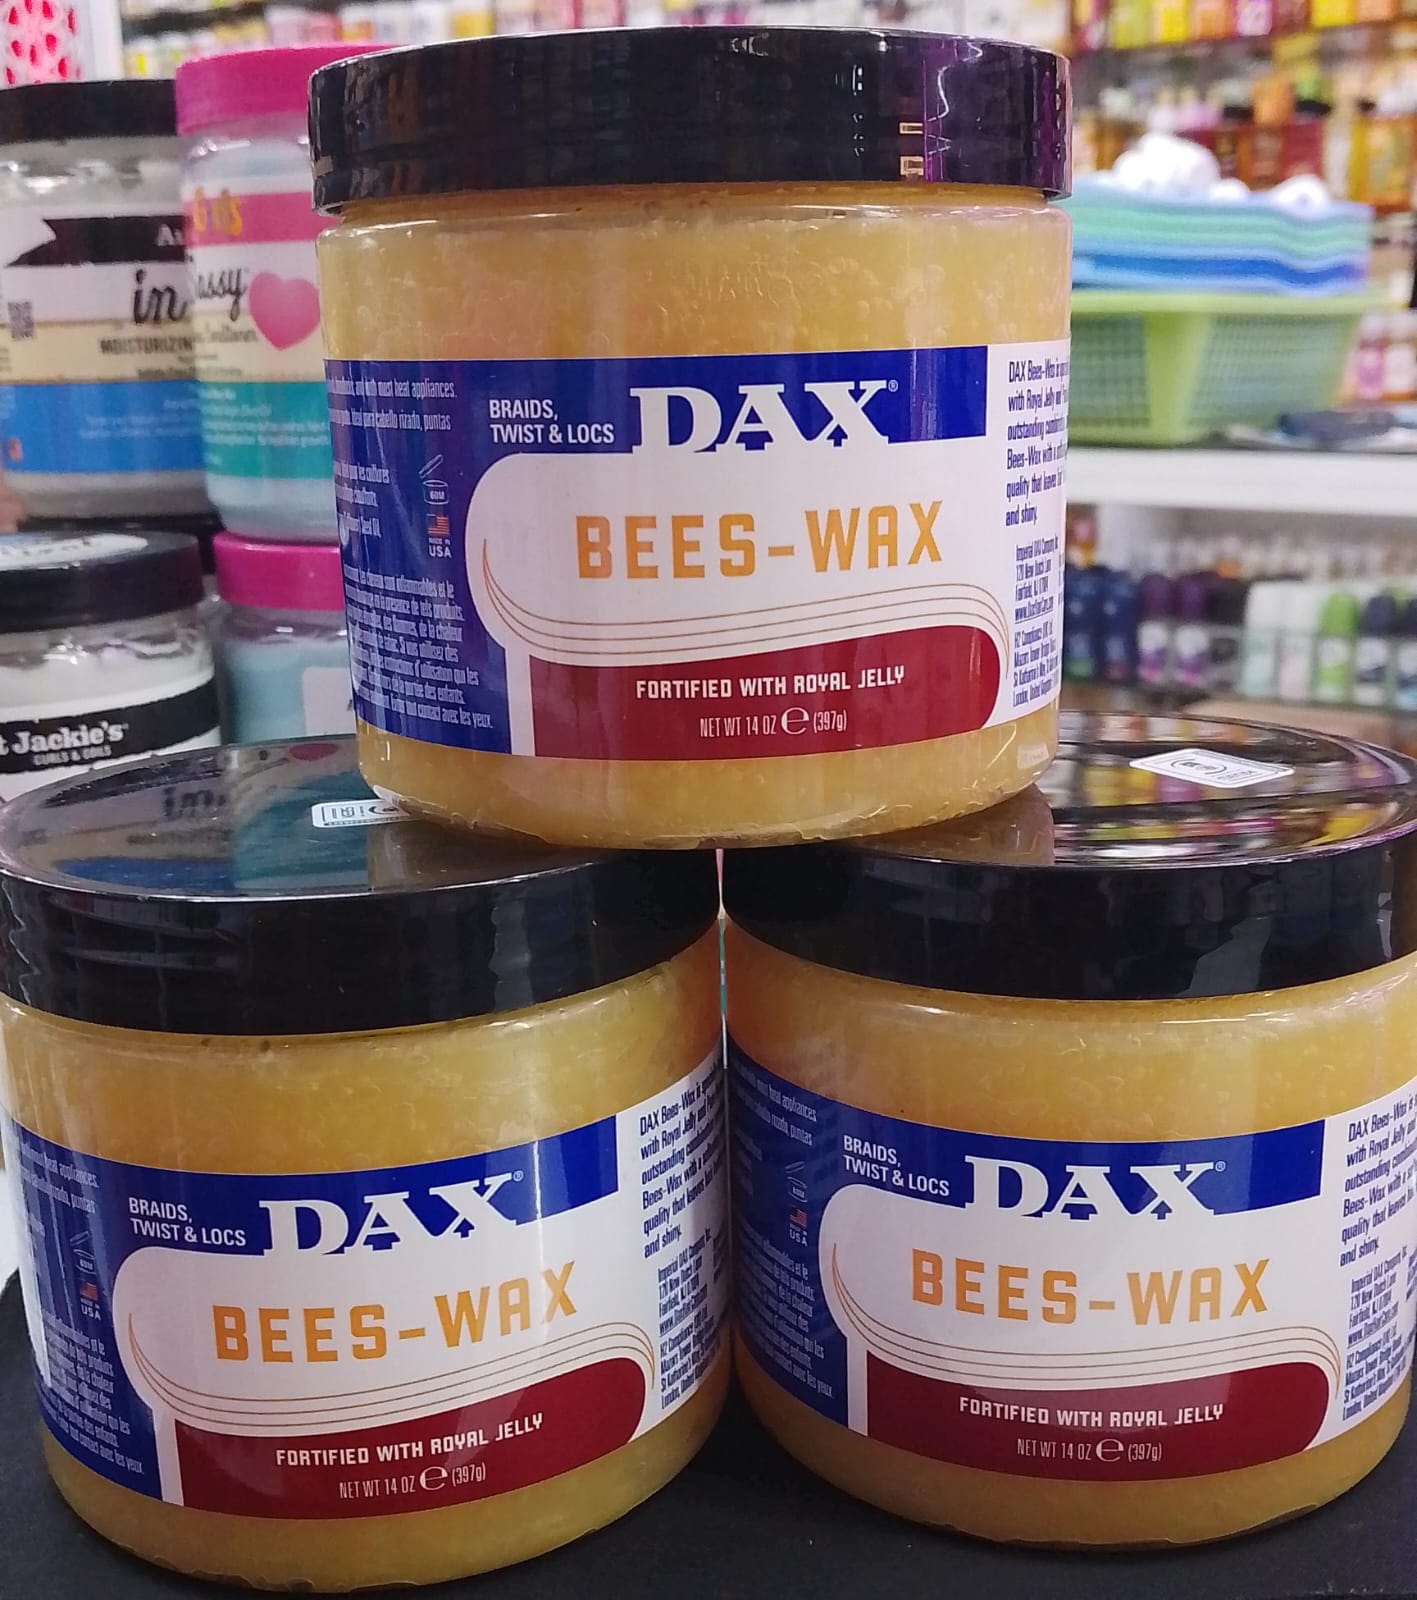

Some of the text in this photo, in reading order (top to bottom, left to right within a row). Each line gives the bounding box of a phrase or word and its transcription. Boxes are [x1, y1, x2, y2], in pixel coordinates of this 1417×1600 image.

[198, 267, 246, 321] assy
[1009, 360, 1027, 383] DAX
[395, 379, 410, 398] heat
[411, 378, 457, 400] appliances.
[1008, 391, 1025, 412] with
[1026, 389, 1043, 413] Royal
[399, 409, 423, 431] rizado,
[423, 413, 451, 432] puntas
[488, 399, 558, 420] BRAIDS,
[490, 423, 615, 444] TWIST & LOCS
[1007, 417, 1044, 441] outstanding
[1007, 445, 1041, 470] Bees-Wax
[1006, 475, 1030, 502] quality
[1031, 474, 1042, 493] that
[1005, 505, 1019, 526] and
[428, 545, 451, 558] USA
[576, 500, 943, 579] BEES-WAX
[636, 664, 905, 699] FORTIFIED WITH ROYAL JELLY
[460, 706, 471, 727] les
[700, 717, 722, 738] NET
[723, 717, 742, 736] WT
[746, 716, 759, 736] 14
[762, 714, 777, 735] OZ
[812, 709, 848, 734] (397g)
[11, 720, 124, 754] Jackie's
[639, 1108, 660, 1136] DAX
[661, 1089, 695, 1125] Bees-Wax
[1348, 1117, 1369, 1142] DAX
[1370, 1100, 1407, 1133] Bees-Wax
[641, 1135, 660, 1160] with
[661, 1121, 682, 1149] Royal
[843, 1135, 901, 1166] BRAIDS,
[1346, 1144, 1366, 1167] with
[1369, 1135, 1390, 1160] Royal
[641, 1149, 685, 1185] outstanding
[842, 1154, 950, 1197] TWIST & LOCS
[1344, 1157, 1390, 1192] outstanding
[642, 1174, 683, 1210] Bees-Wax
[1343, 1183, 1386, 1218] Bees-Wax
[128, 1197, 193, 1224] BRAIDS,
[643, 1206, 670, 1236] quality
[671, 1193, 686, 1214] that
[130, 1219, 247, 1247] TWIST & LOCS
[644, 1223, 682, 1259] and shiny.
[789, 1228, 808, 1247] USA
[1342, 1217, 1370, 1246] quality
[1372, 1207, 1386, 1227] that
[1340, 1243, 1356, 1267] and
[911, 1247, 1270, 1326] BEES-WAX
[81, 1304, 101, 1321] USA
[212, 1261, 577, 1363] BEES-WAX
[960, 1397, 1224, 1428] FORTIFIED WITH ROYAL JELLY
[276, 1412, 543, 1466] FORTIFIED WITH ROYAL JELLY
[1016, 1438, 1038, 1457] NET
[1040, 1440, 1056, 1458] WT
[1061, 1442, 1074, 1459] 14
[1078, 1443, 1091, 1460] OZ
[1128, 1443, 1162, 1462] (397g)
[339, 1480, 360, 1498] NET
[362, 1479, 381, 1497] WT
[384, 1477, 398, 1496] 14
[401, 1476, 416, 1494] OZ
[452, 1462, 486, 1487] (397g)
